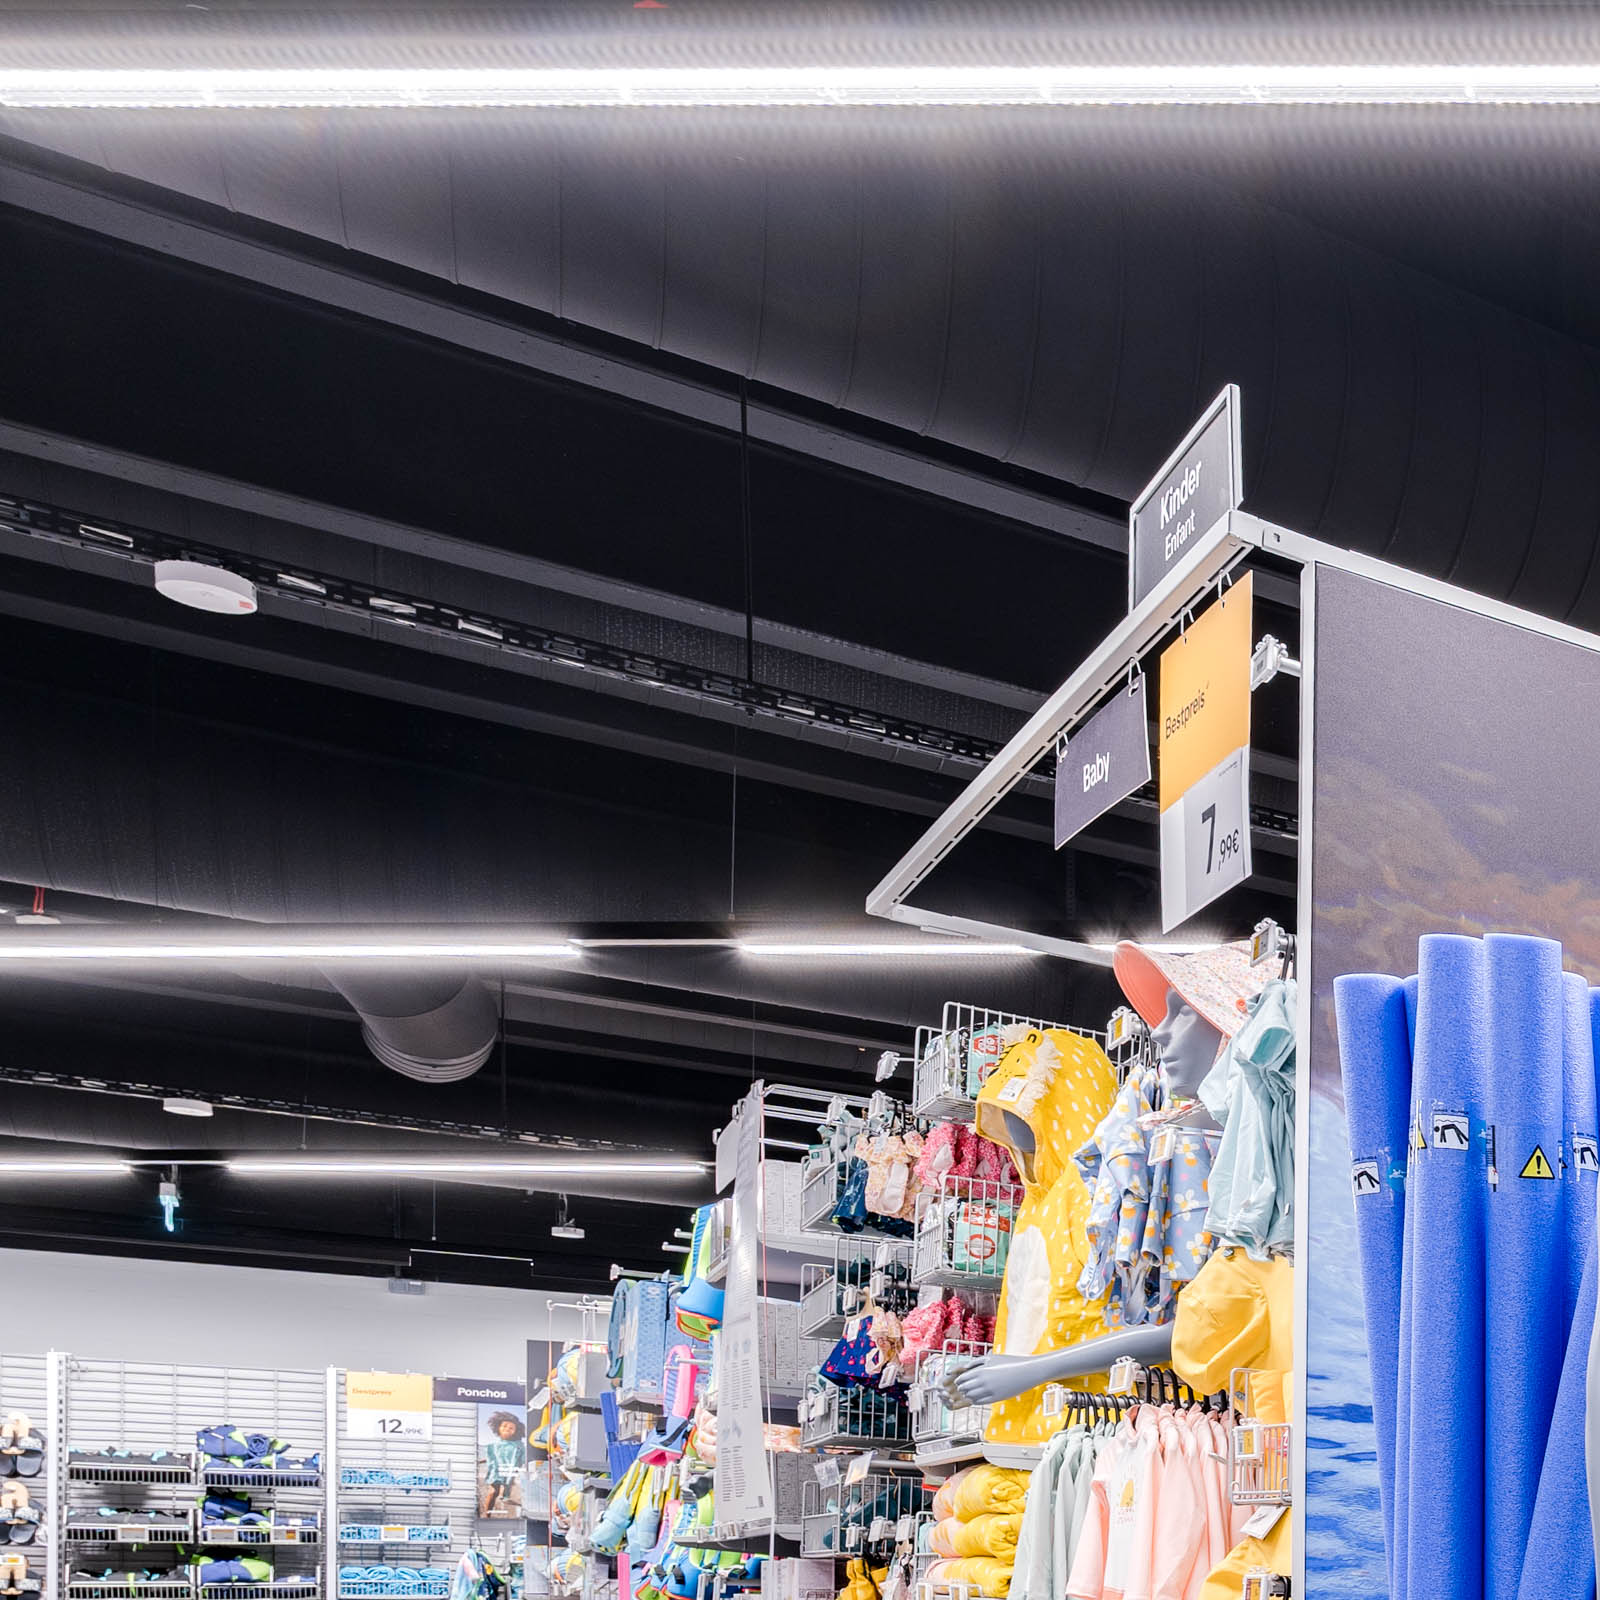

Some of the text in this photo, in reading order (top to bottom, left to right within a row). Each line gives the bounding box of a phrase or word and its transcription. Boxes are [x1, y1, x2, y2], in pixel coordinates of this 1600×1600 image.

[1160, 461, 1202, 530] Kinder
[1165, 509, 1195, 561] Enfant
[1165, 691, 1206, 740] Bestpreis
[1083, 752, 1110, 792] Baby
[1201, 803, 1240, 875] 7,99€
[457, 1387, 508, 1399] Ponchos
